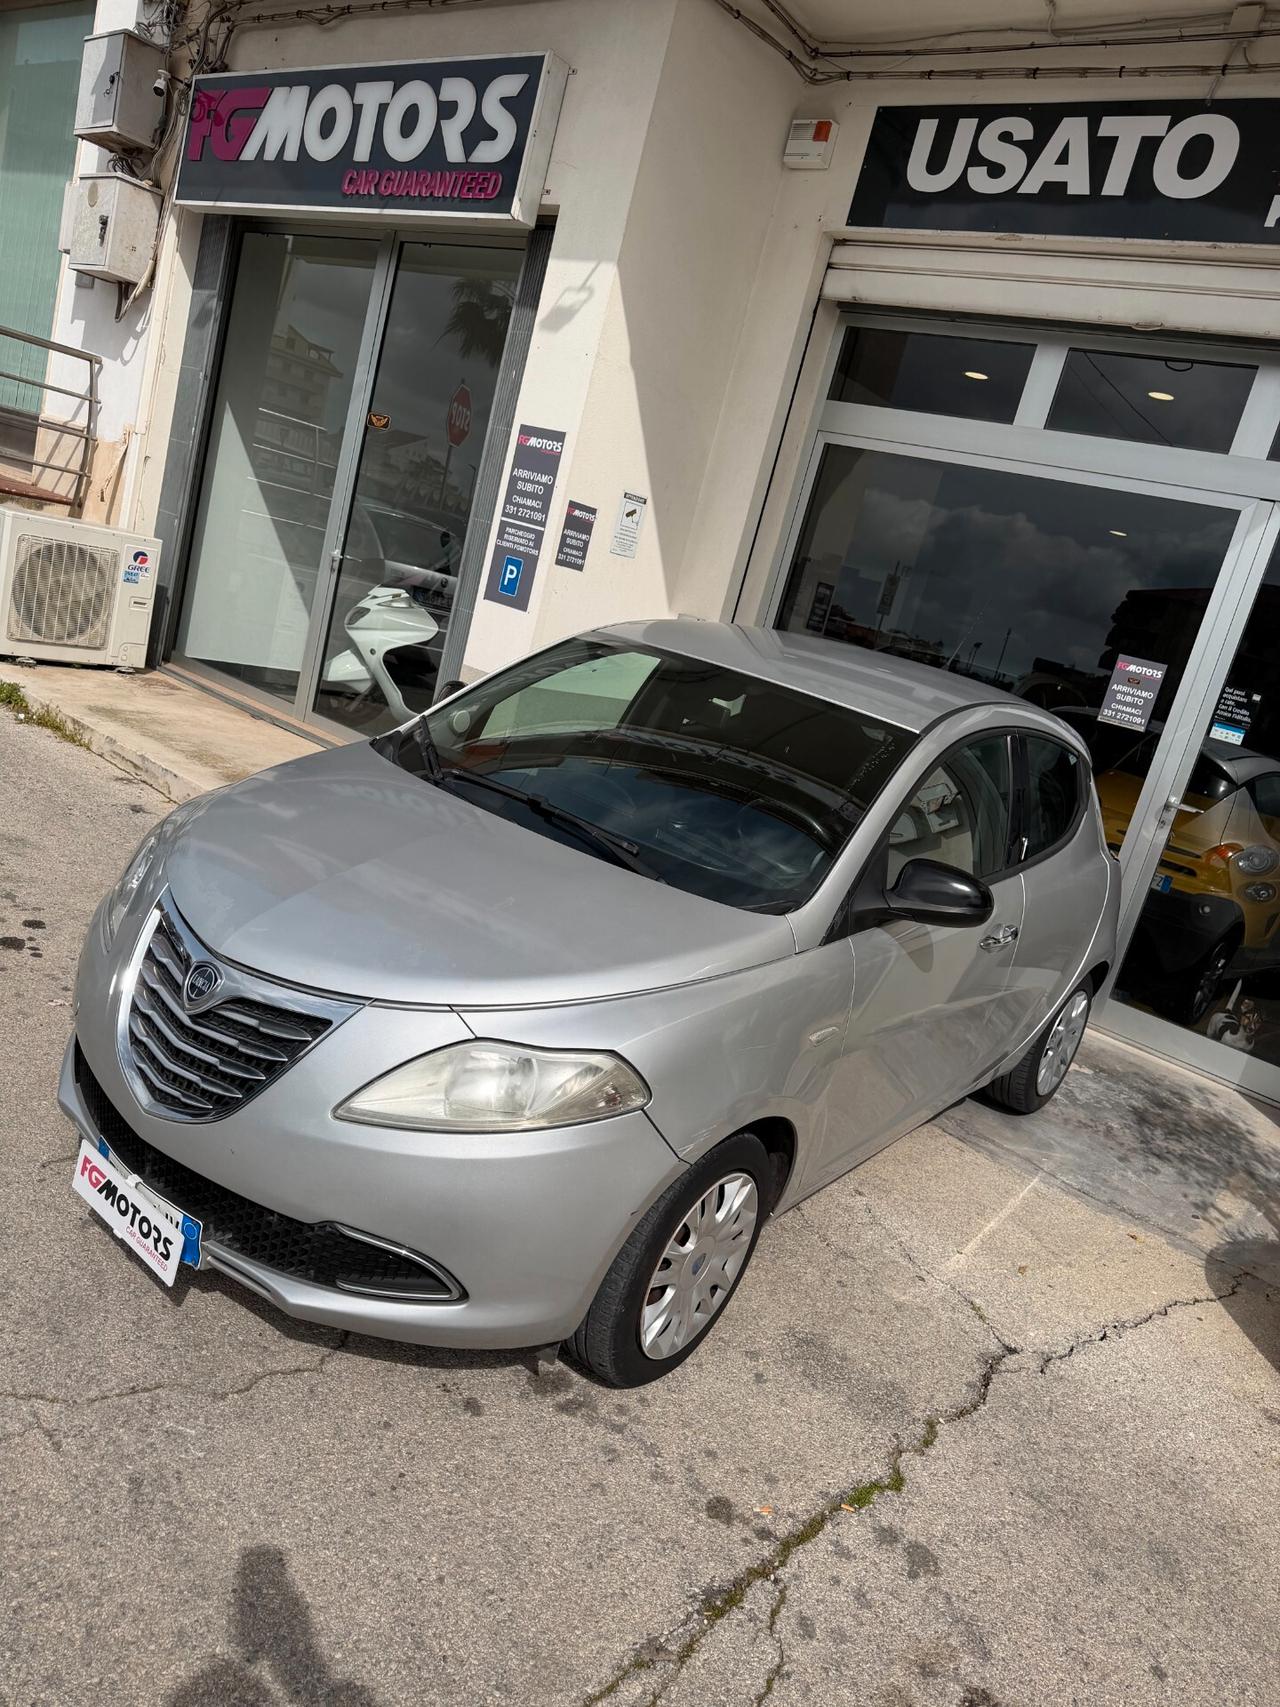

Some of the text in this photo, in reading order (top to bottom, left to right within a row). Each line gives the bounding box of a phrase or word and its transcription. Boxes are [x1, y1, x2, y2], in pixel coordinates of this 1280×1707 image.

[906, 113, 1241, 199] USATO
[342, 169, 503, 199] CAR GUARANTEED
[512, 468, 554, 485] ARRIVIAMO
[516, 481, 544, 494] SUBITO
[512, 495, 543, 509] CHIAMACI
[504, 504, 546, 522] 331 2721091
[563, 529, 590, 542] ARRIVIAMO
[565, 537, 584, 548] SUBITO
[503, 565, 517, 586] P
[1116, 662, 1163, 678] FGMOTORS
[1111, 683, 1154, 699] ARRIVIAMO
[1115, 693, 1144, 706] SUBITO
[1102, 708, 1116, 717] 331
[1116, 712, 1145, 725] 2721091
[1111, 702, 1142, 715] CHIAMACI
[80, 1155, 174, 1261] FGMOTORS
[125, 1225, 168, 1272] CAR GUARANTEED
